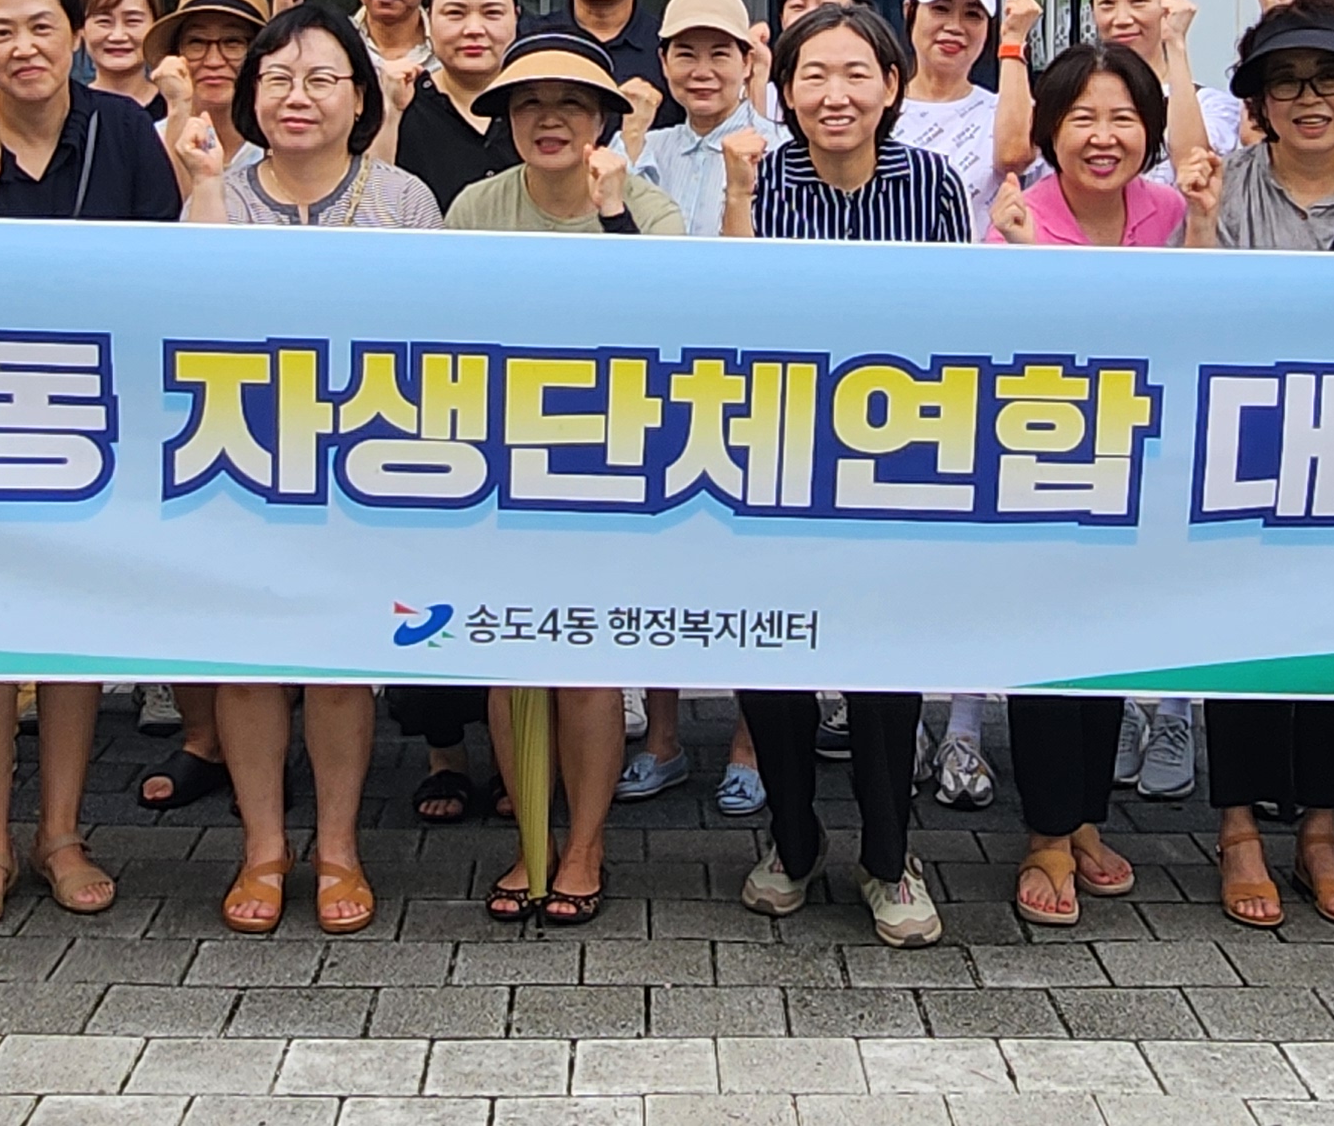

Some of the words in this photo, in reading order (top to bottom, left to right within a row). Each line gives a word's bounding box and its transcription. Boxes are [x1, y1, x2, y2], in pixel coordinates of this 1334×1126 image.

[162, 337, 1163, 526] 자생단체연합
[464, 603, 599, 646] 송도4동
[607, 605, 819, 650] 행정복지센터
